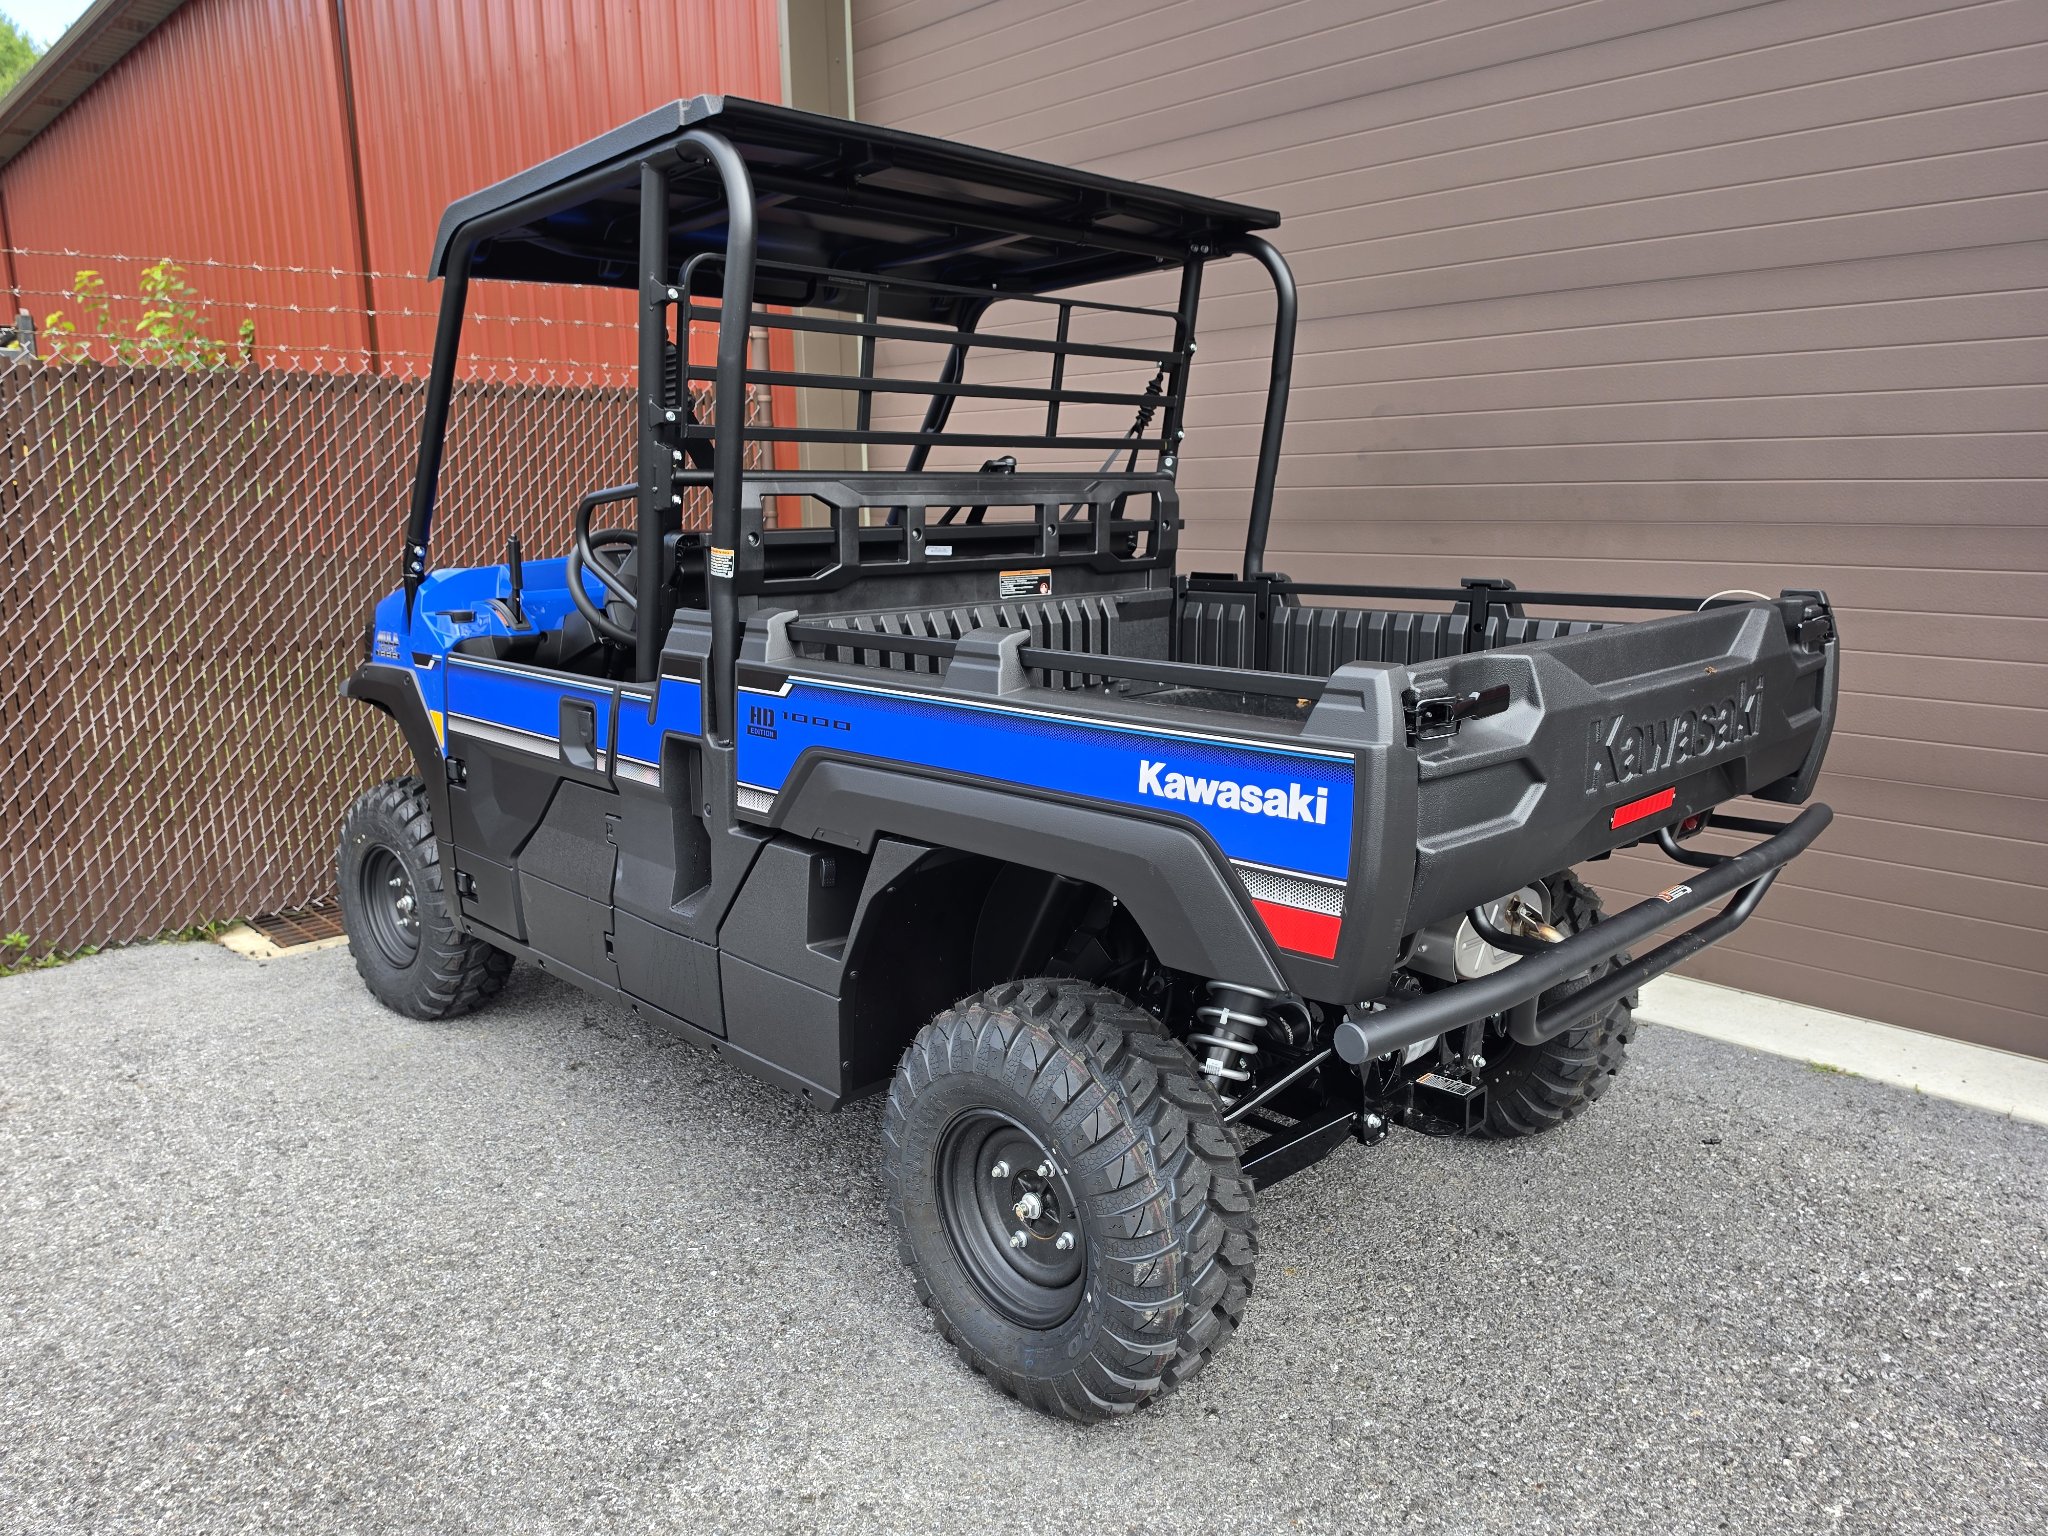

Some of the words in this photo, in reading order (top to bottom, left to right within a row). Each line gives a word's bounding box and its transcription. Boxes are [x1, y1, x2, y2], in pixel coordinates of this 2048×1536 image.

[750, 705, 775, 727] HD
[783, 711, 850, 731] 1000
[750, 727, 775, 738] EDITION
[1586, 674, 1764, 795] Kawasaki
[1138, 759, 1329, 825] Kawasaki
